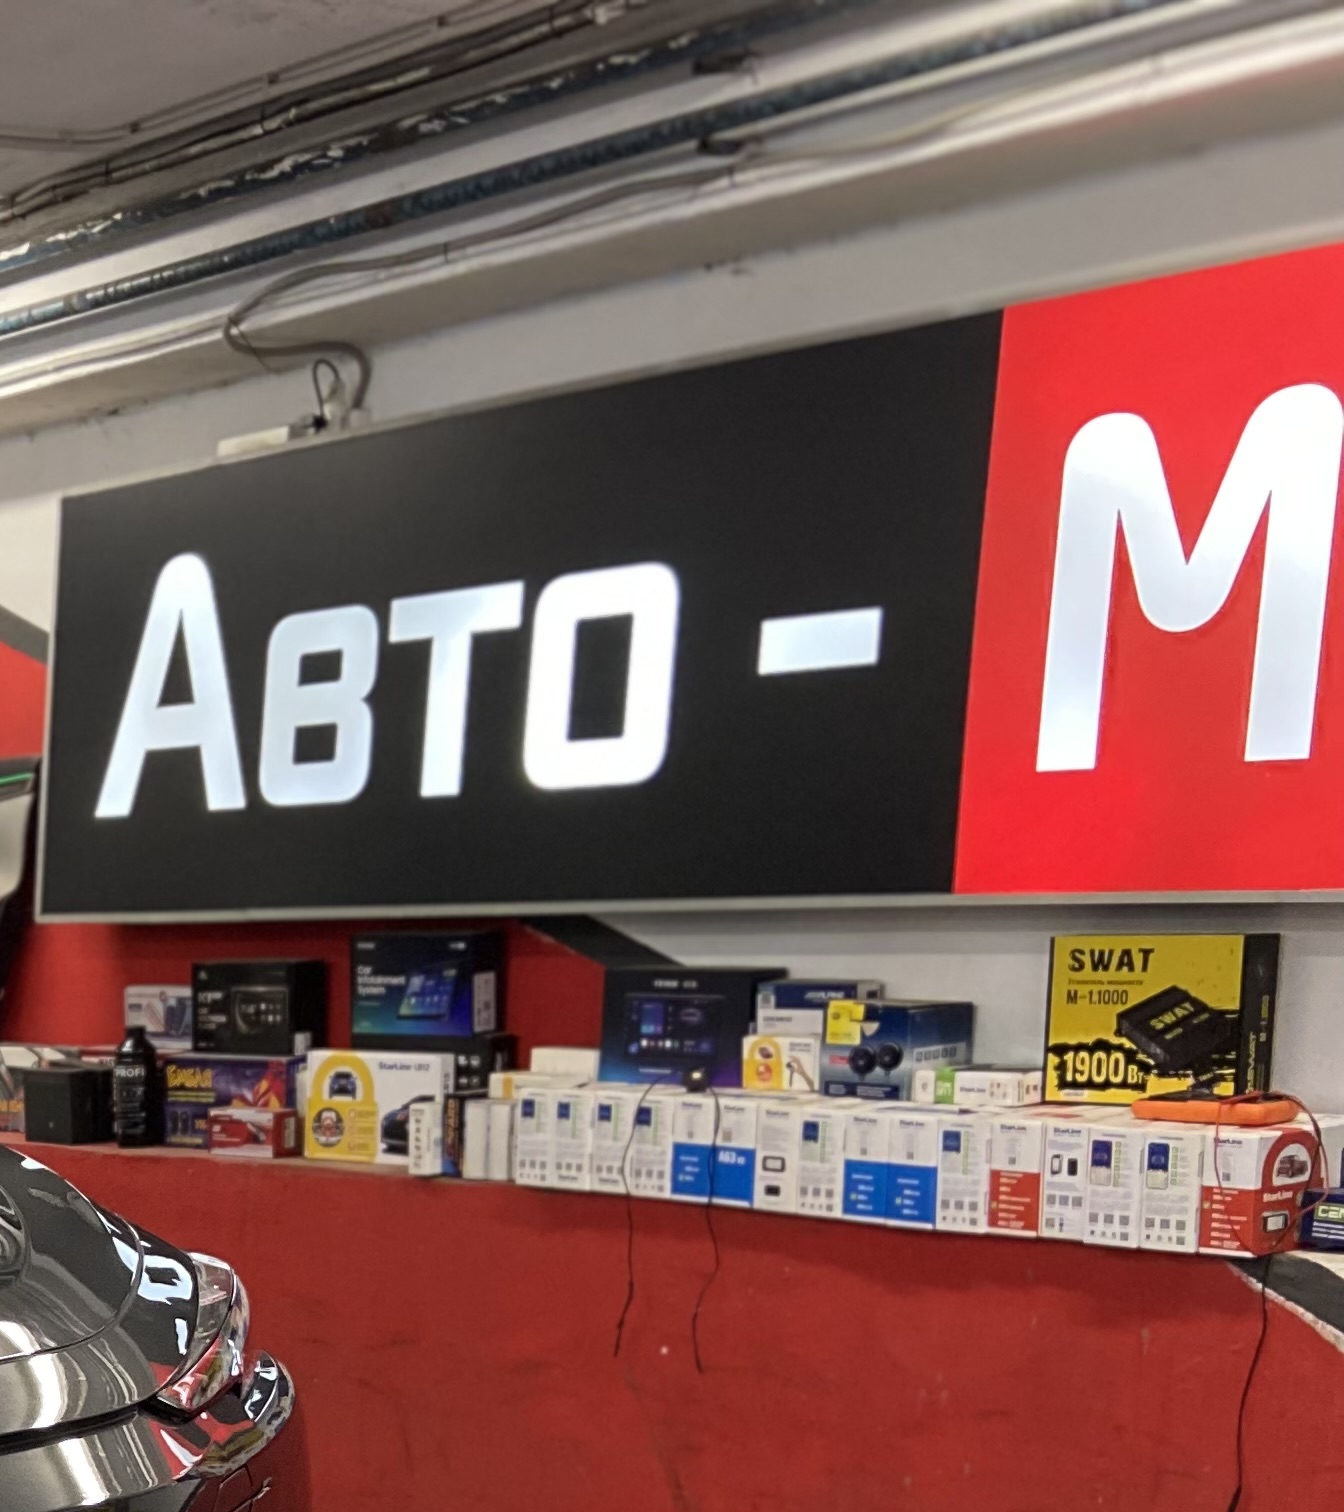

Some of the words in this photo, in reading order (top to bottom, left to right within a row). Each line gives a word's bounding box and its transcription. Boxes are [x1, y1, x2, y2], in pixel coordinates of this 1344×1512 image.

[95, 552, 680, 818] Авто
[1068, 948, 1154, 973] SWAT
[1150, 1001, 1195, 1031] SWAT
[1063, 1051, 1126, 1084] 1900
